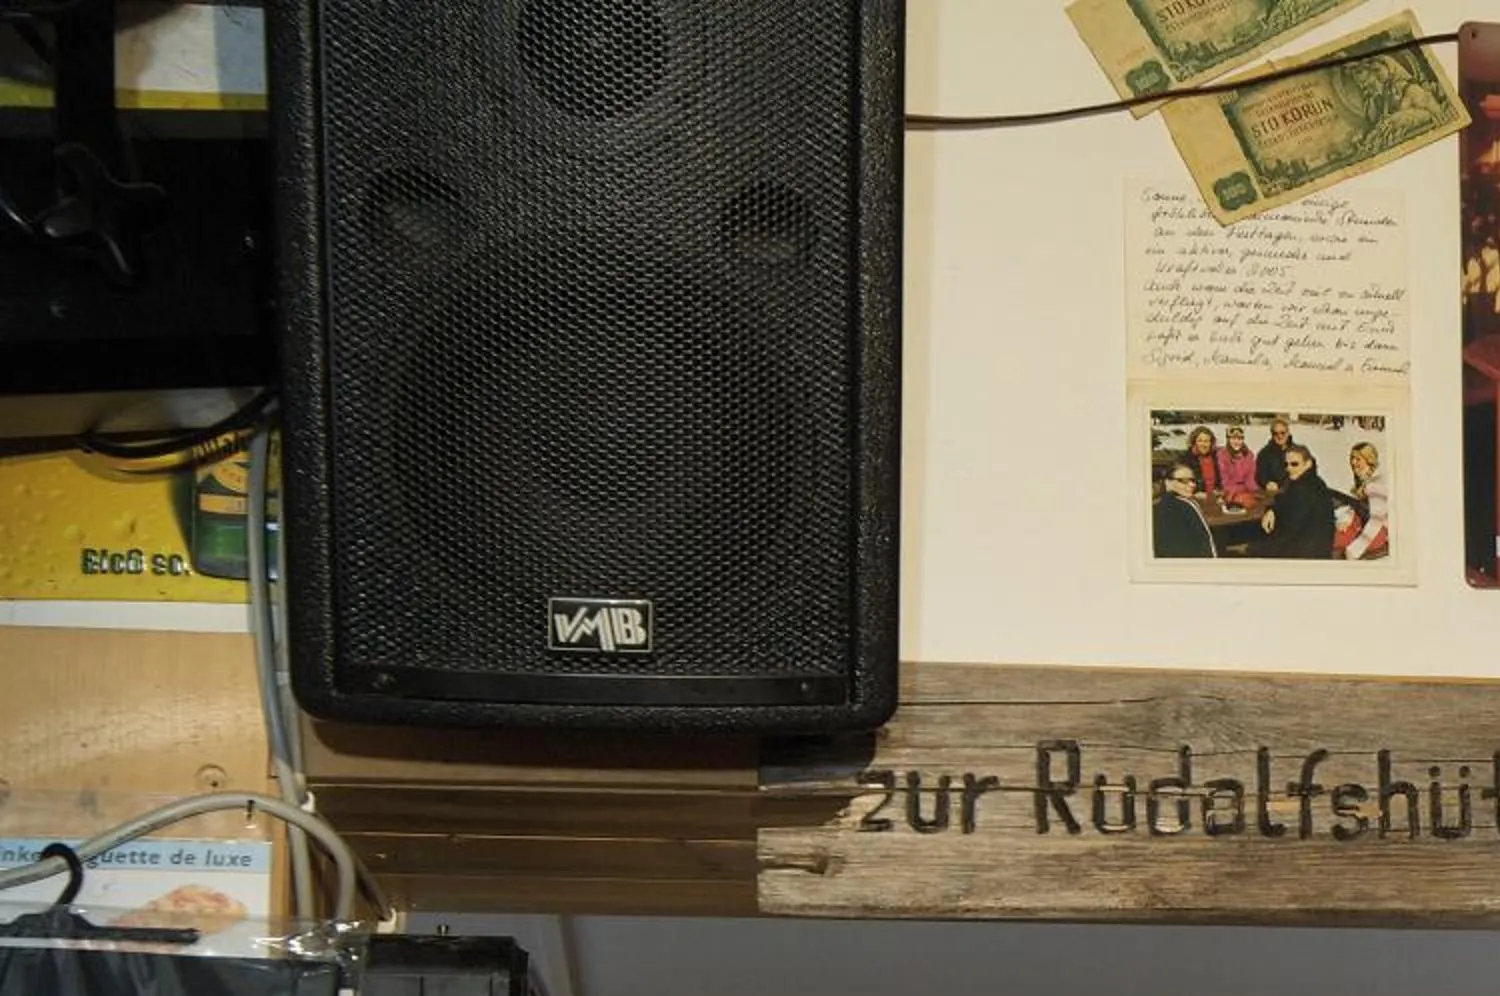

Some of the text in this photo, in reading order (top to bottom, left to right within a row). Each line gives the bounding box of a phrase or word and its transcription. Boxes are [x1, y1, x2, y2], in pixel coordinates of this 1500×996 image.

[553, 606, 647, 651] VMB
[854, 768, 999, 837] zur
[170, 850, 196, 867] de
[204, 850, 253, 868] luxe
